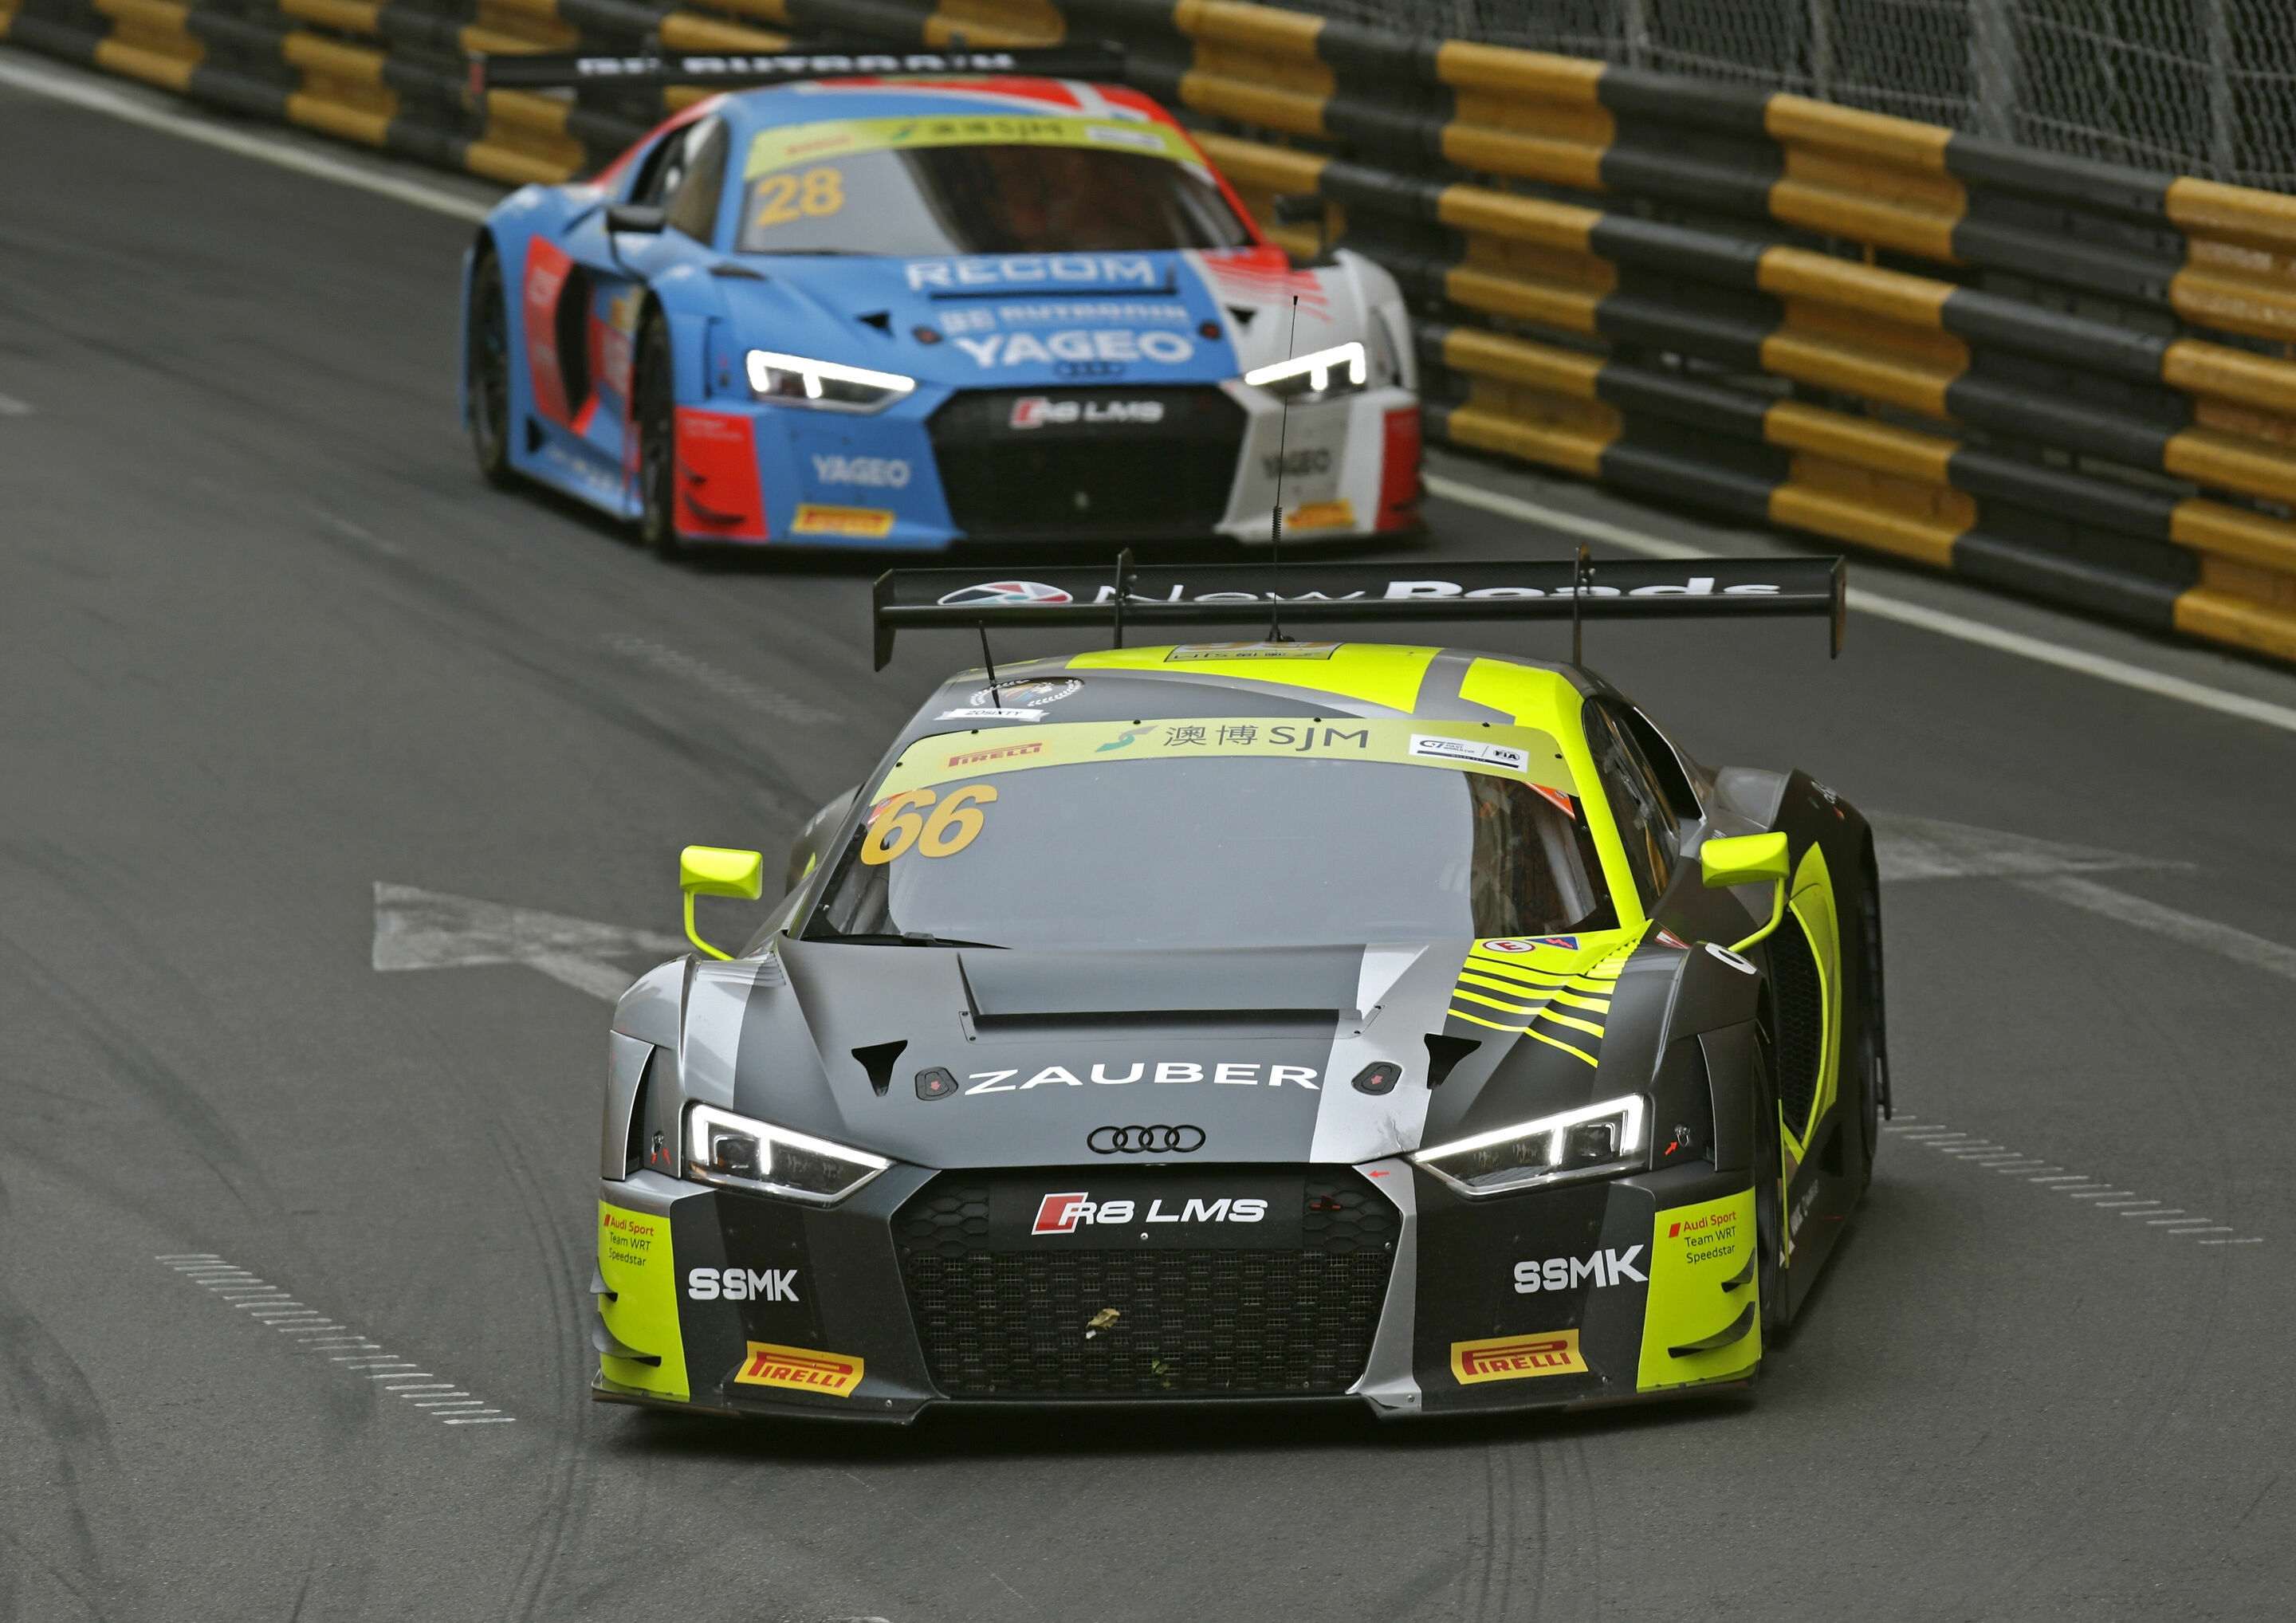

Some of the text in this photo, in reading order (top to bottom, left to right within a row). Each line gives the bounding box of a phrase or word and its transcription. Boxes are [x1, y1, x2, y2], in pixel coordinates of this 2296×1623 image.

[756, 167, 846, 229] 28
[906, 256, 1155, 291] RECOM
[953, 330, 1193, 368] YAGEO
[812, 454, 910, 488] YAGEO
[1163, 724, 1260, 747] 澳博
[1268, 725, 1369, 752] SJM
[949, 742, 1043, 768] PIRELLI
[1495, 749, 1517, 760] FIA
[861, 784, 997, 866] 66
[964, 1062, 1321, 1096] ZAUBER
[611, 1216, 655, 1236] Audi Sport
[1057, 1197, 1268, 1228] R8 LMS
[1684, 1211, 1736, 1232] Audi Sport
[610, 1232, 651, 1251] Team WRT
[1685, 1226, 1736, 1248] Team WRT
[608, 1248, 647, 1266] Speedstar
[1514, 1244, 1649, 1294] SSMK
[1686, 1244, 1736, 1265] Speedstar
[688, 1267, 800, 1302] SSMK
[748, 1351, 854, 1389] PIRELLI
[1461, 1340, 1571, 1376] PIRELLI
